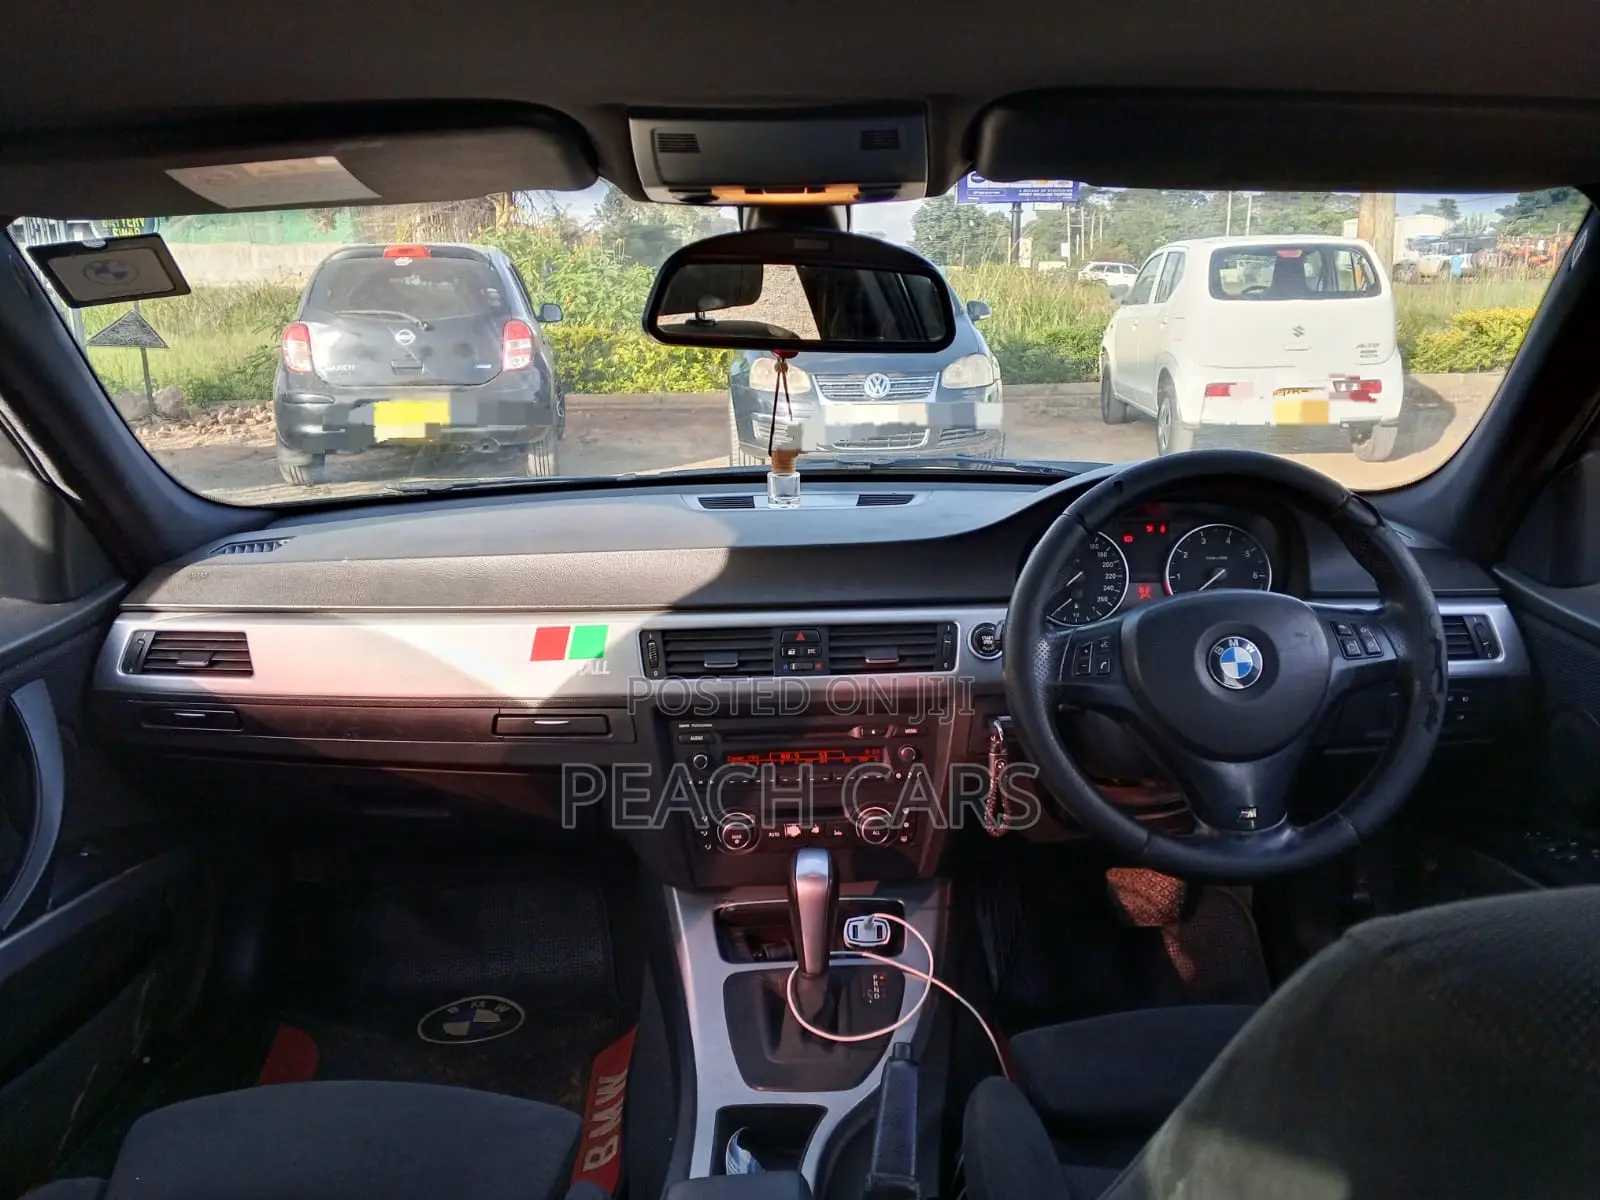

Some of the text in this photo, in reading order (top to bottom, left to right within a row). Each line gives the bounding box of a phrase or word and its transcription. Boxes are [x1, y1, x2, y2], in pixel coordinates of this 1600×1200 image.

[1201, 537, 1207, 545] 3
[1225, 537, 1231, 545] 4
[1183, 551, 1189, 559] 2
[1214, 638, 1256, 656] BMW
[447, 1000, 511, 1014] BMW
[582, 1069, 628, 1172] BMW
